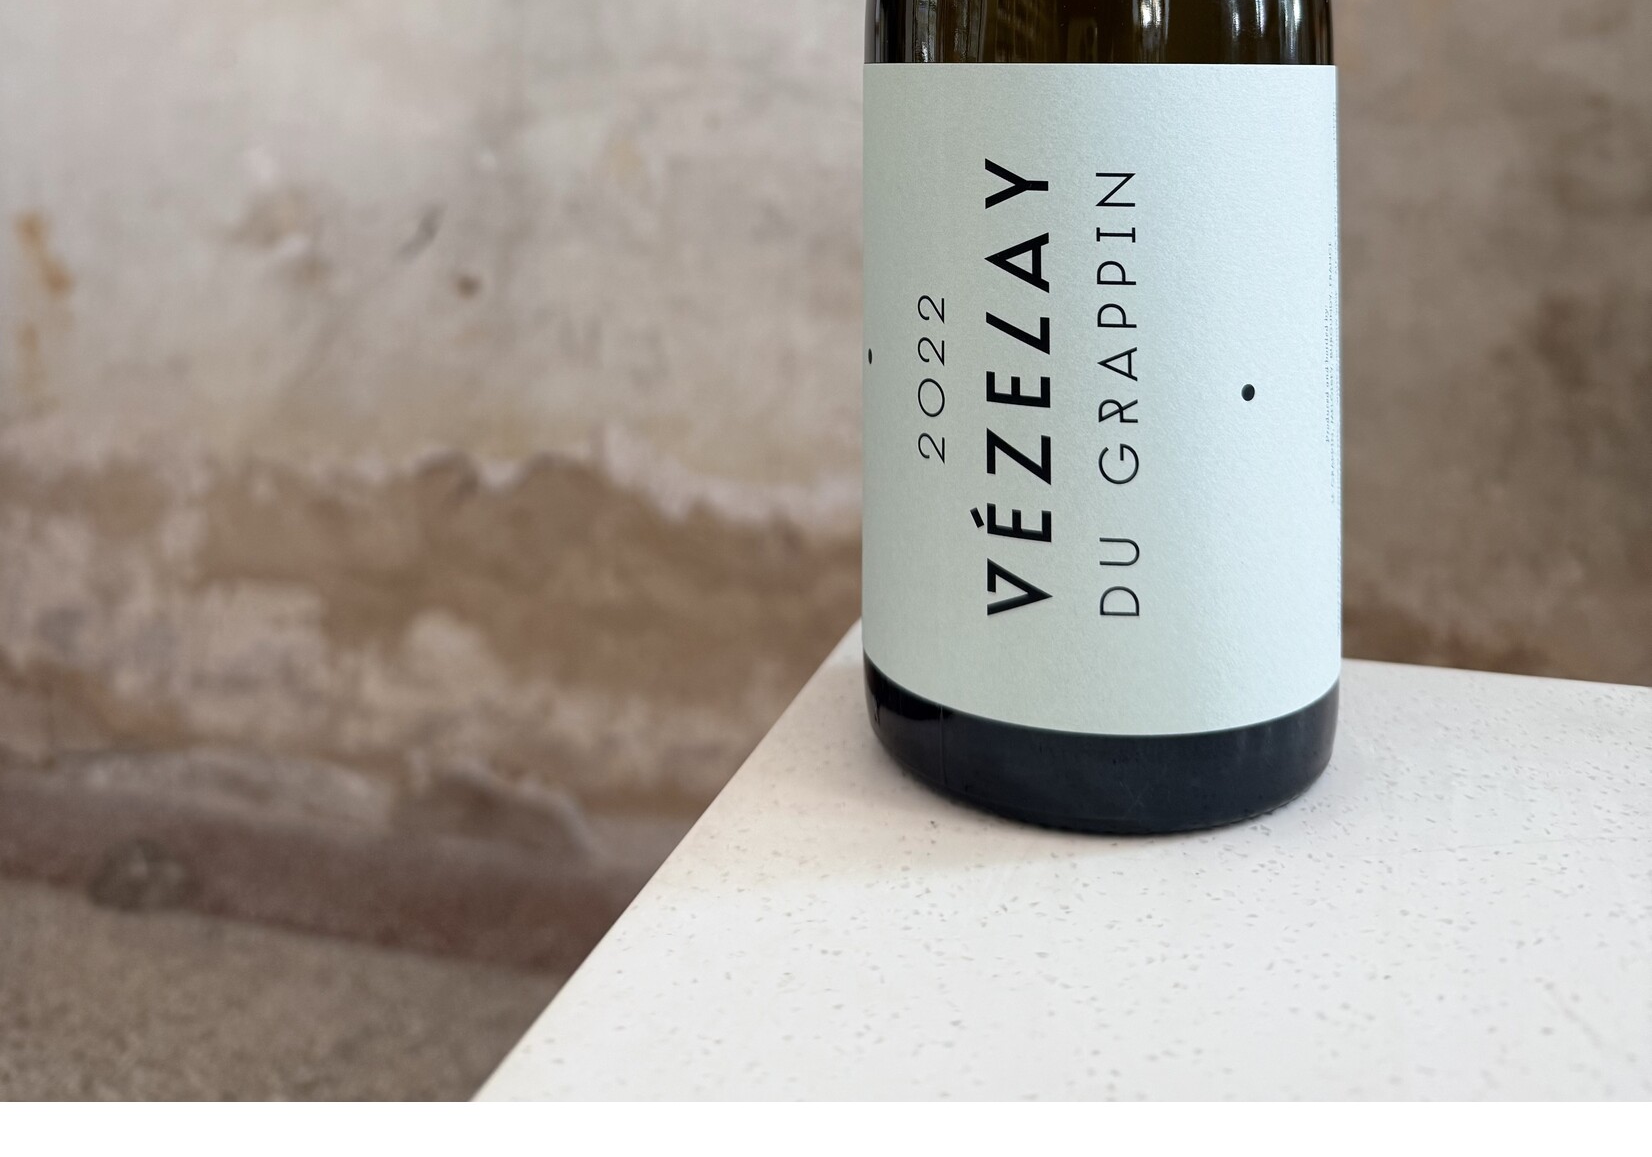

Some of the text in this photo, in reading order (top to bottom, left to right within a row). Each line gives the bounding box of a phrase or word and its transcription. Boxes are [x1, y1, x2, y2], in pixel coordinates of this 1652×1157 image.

[917, 294, 946, 465] 2022
[969, 157, 1054, 617] VÉZELAY
[1095, 172, 1141, 617] DU GRAPPIN
